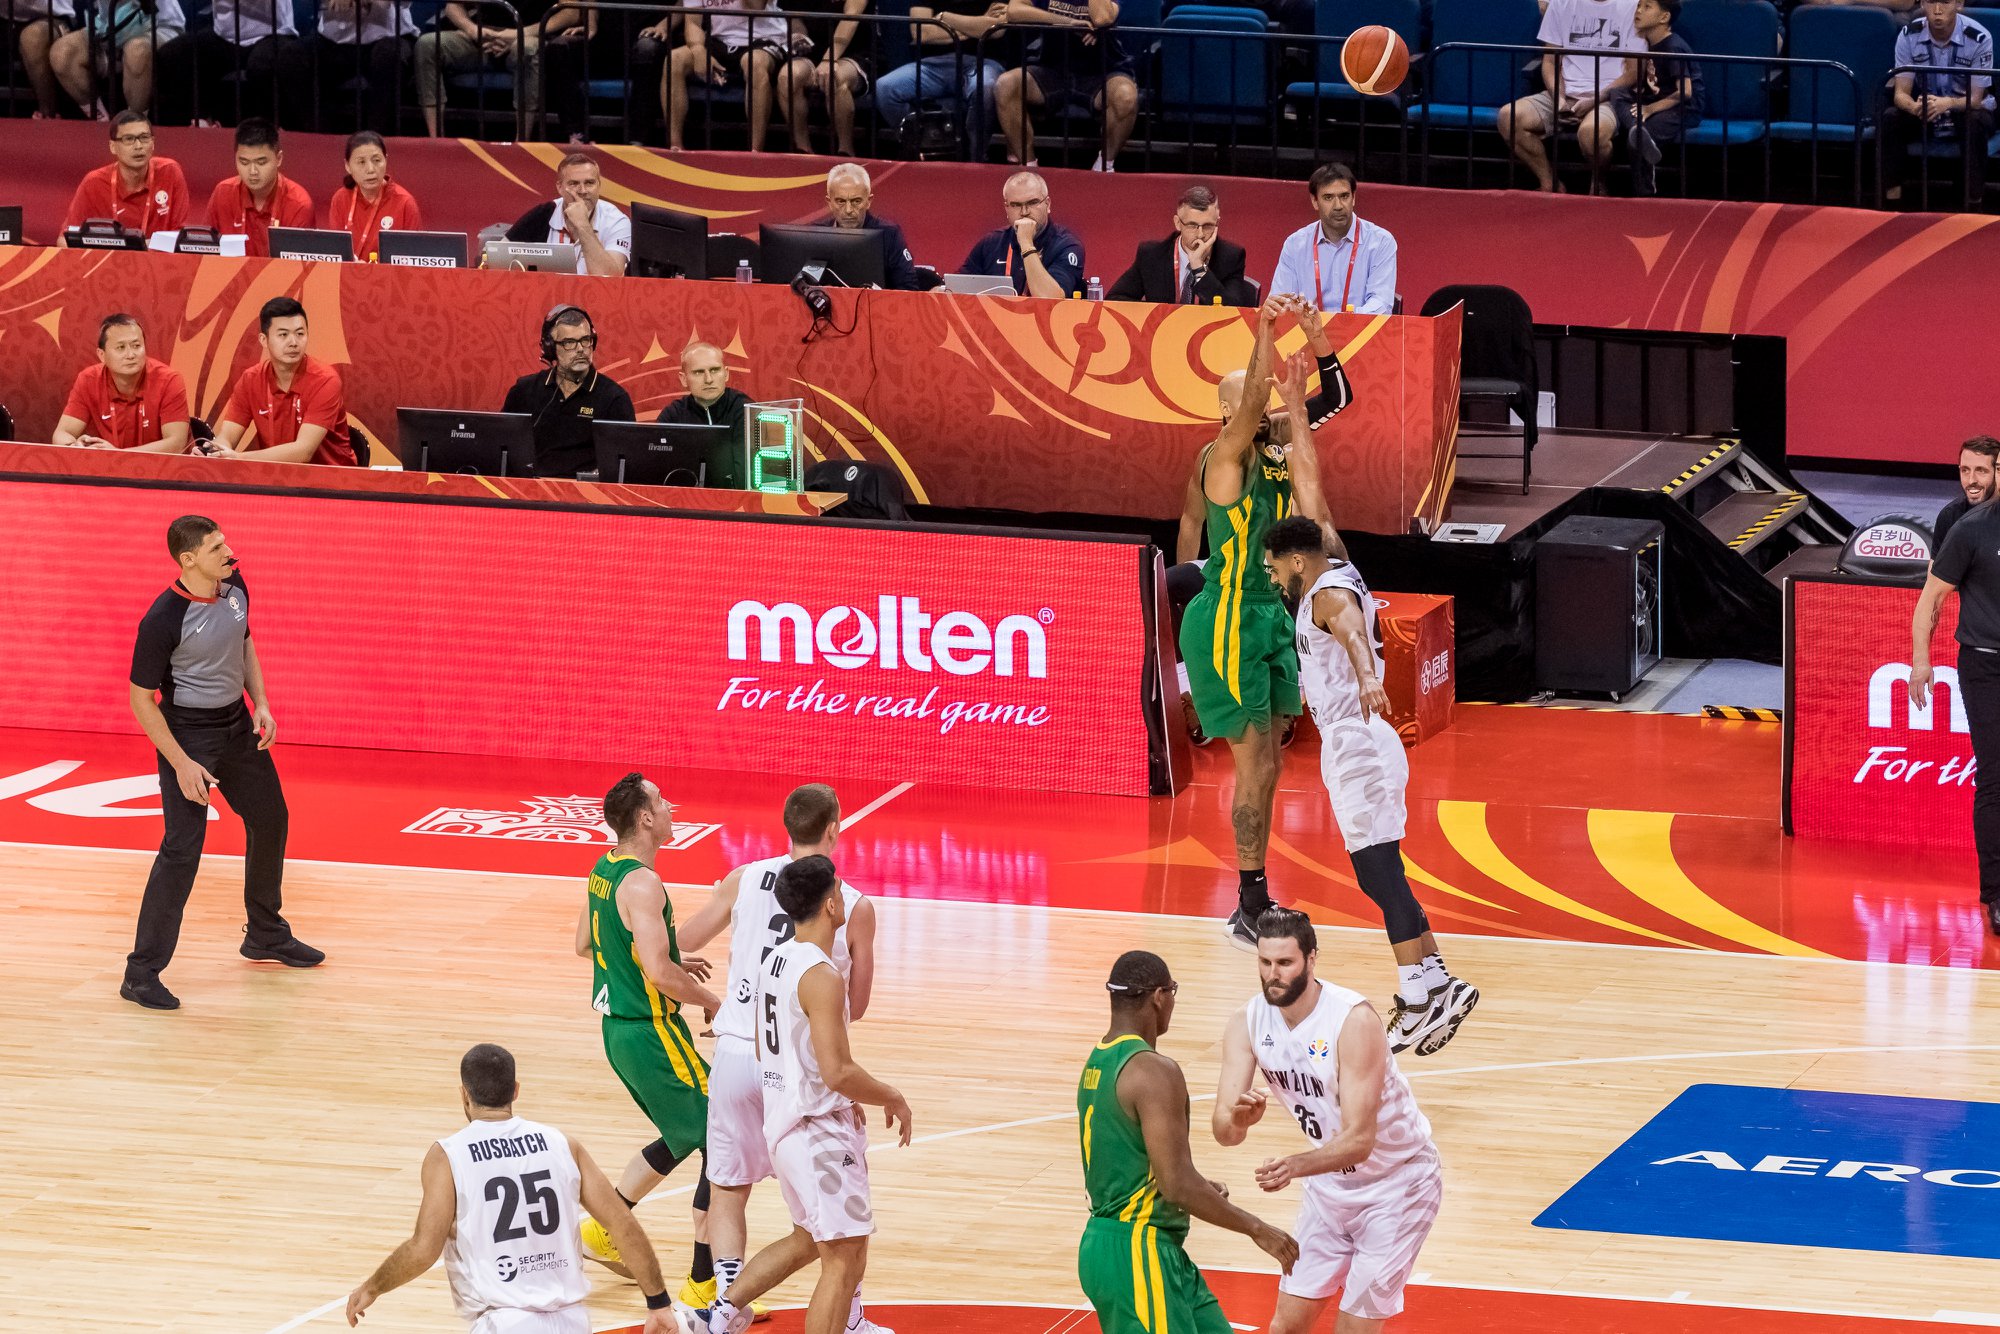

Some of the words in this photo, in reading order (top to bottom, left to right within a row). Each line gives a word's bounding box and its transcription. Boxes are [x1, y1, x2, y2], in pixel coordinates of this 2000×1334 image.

[299, 254, 341, 262] TISSOT
[410, 257, 454, 267] TISSOT
[755, 413, 793, 495] 2
[1870, 529, 1912, 541] 百岁山
[728, 594, 1048, 678] molten
[717, 677, 782, 711] For
[786, 678, 851, 715] the
[853, 685, 937, 718] real
[940, 698, 1052, 734] game
[1853, 746, 1935, 784] For
[765, 992, 780, 1055] 5
[1294, 1104, 1323, 1140] 35
[468, 1132, 549, 1163] RUSBATCH
[1649, 1150, 2000, 1188] AERO
[484, 1169, 560, 1243] 25
[519, 1252, 556, 1265] SECURITY
[520, 1259, 569, 1274] PLACEMENTS
